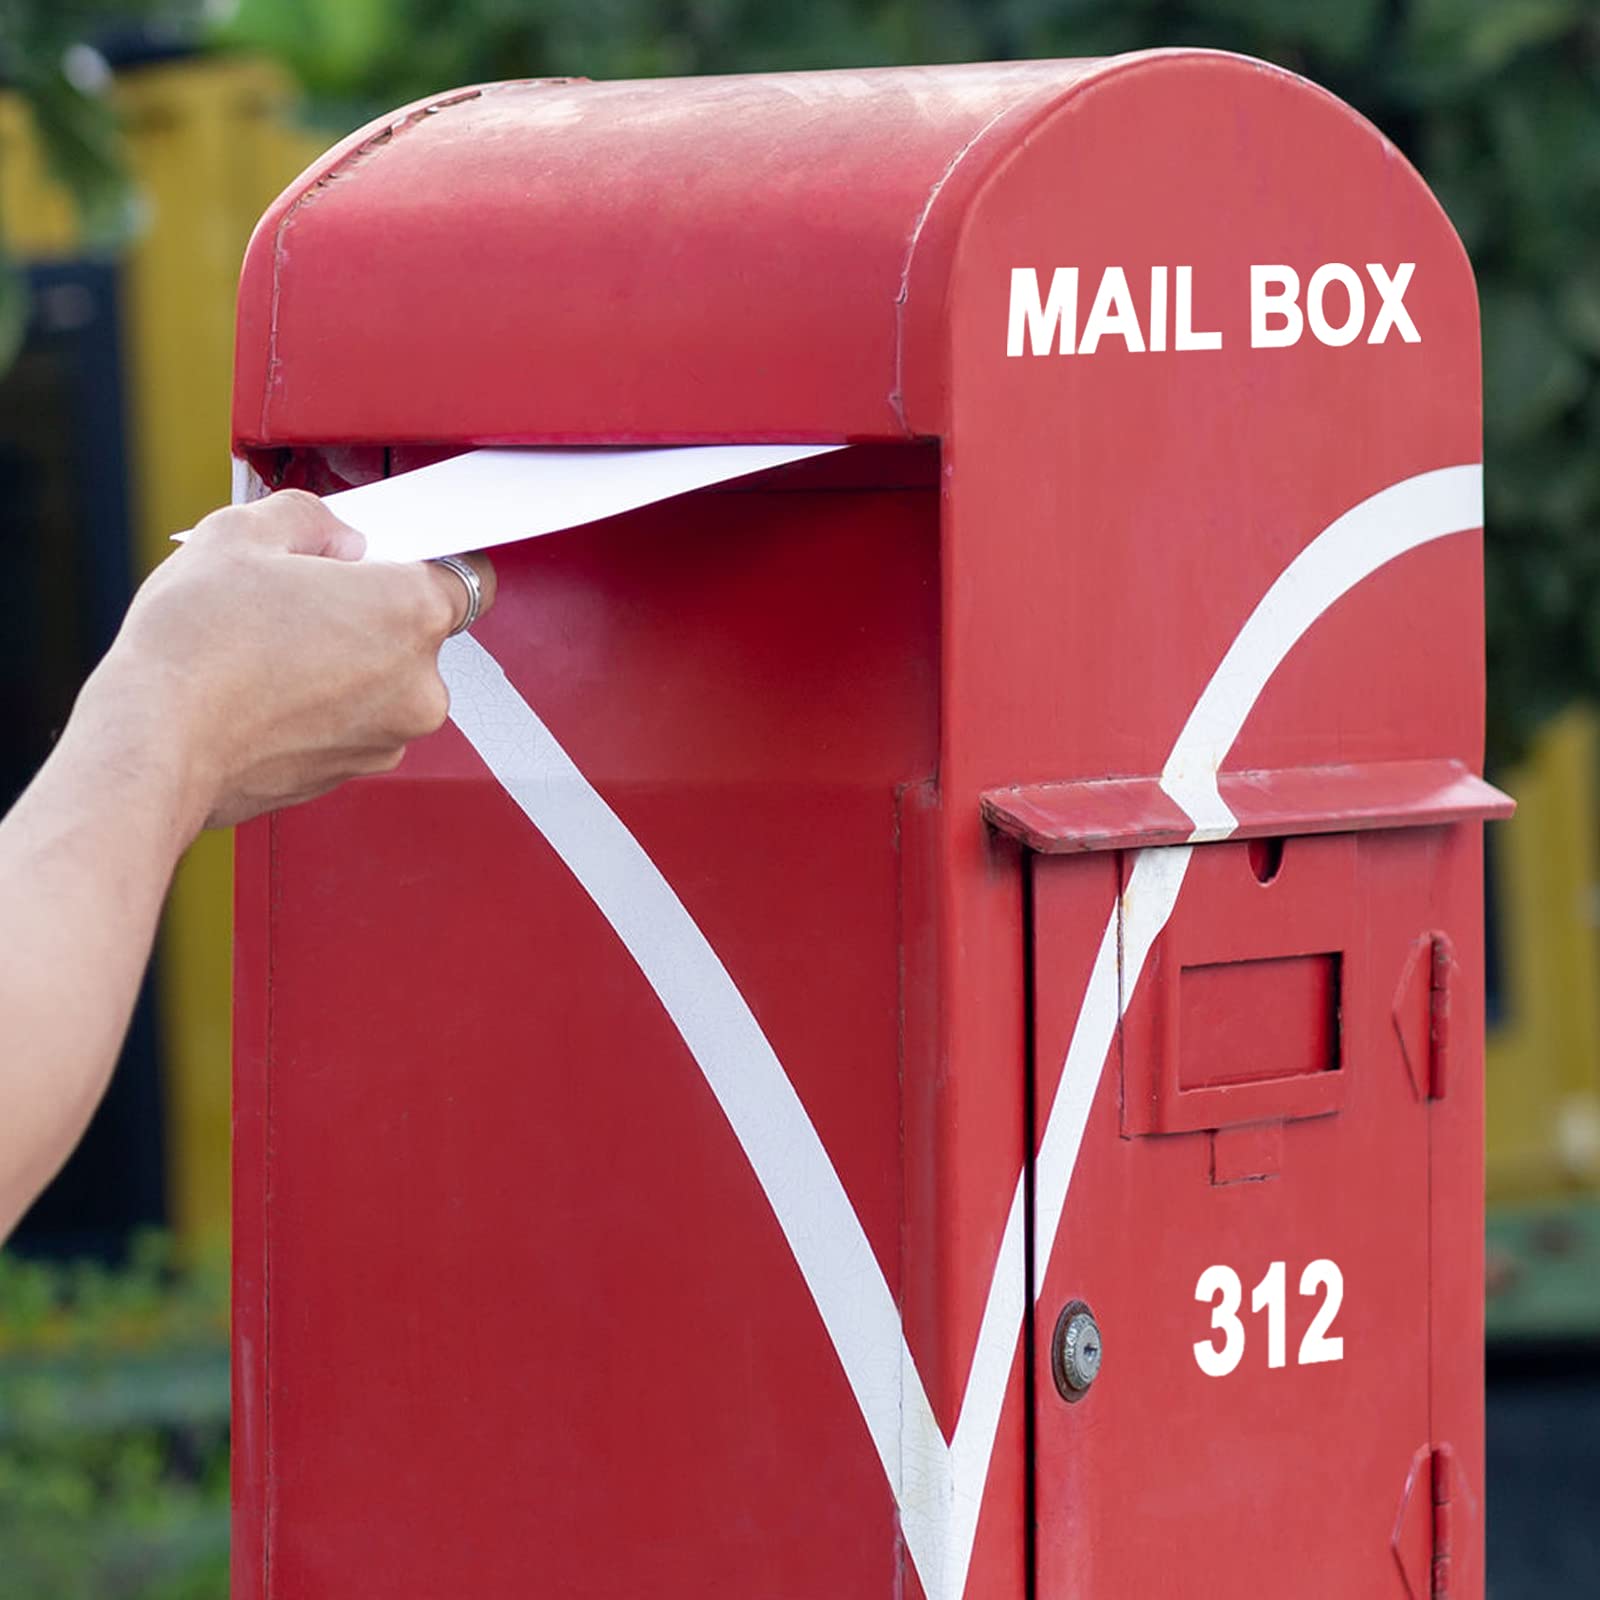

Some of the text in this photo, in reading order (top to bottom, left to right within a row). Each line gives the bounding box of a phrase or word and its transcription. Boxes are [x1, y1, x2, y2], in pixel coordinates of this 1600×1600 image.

[1006, 262, 1422, 357] MAIL BOX
[1193, 1259, 1344, 1377] 312
